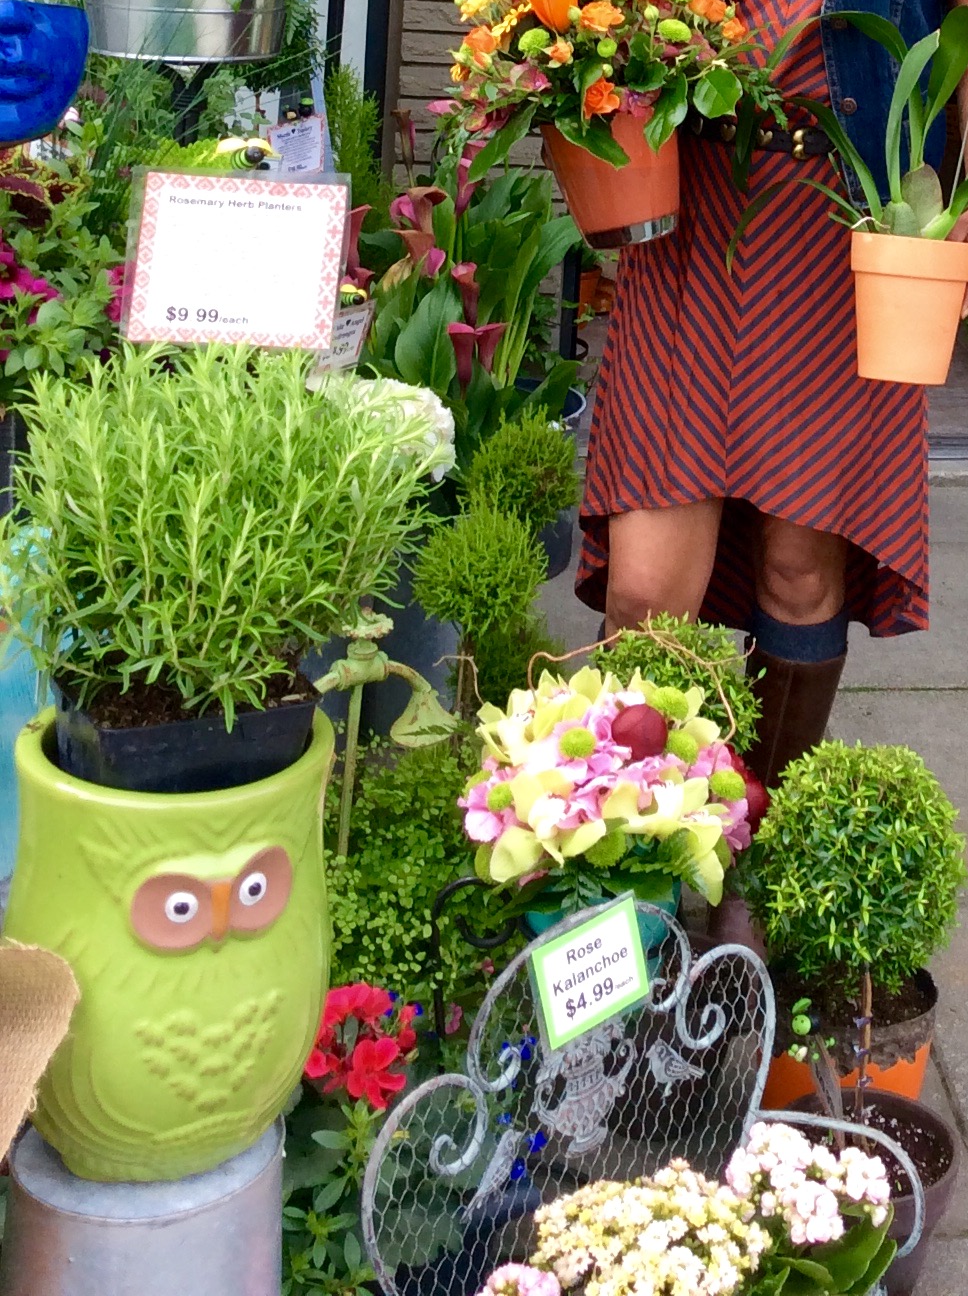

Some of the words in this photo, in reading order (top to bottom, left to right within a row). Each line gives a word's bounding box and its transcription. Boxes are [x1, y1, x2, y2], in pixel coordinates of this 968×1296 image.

[169, 195, 224, 208] Rosemary
[228, 199, 254, 208] Herb
[258, 200, 302, 212] Planters
[566, 937, 603, 965] Rose
[552, 946, 629, 997] Kalanchoe
